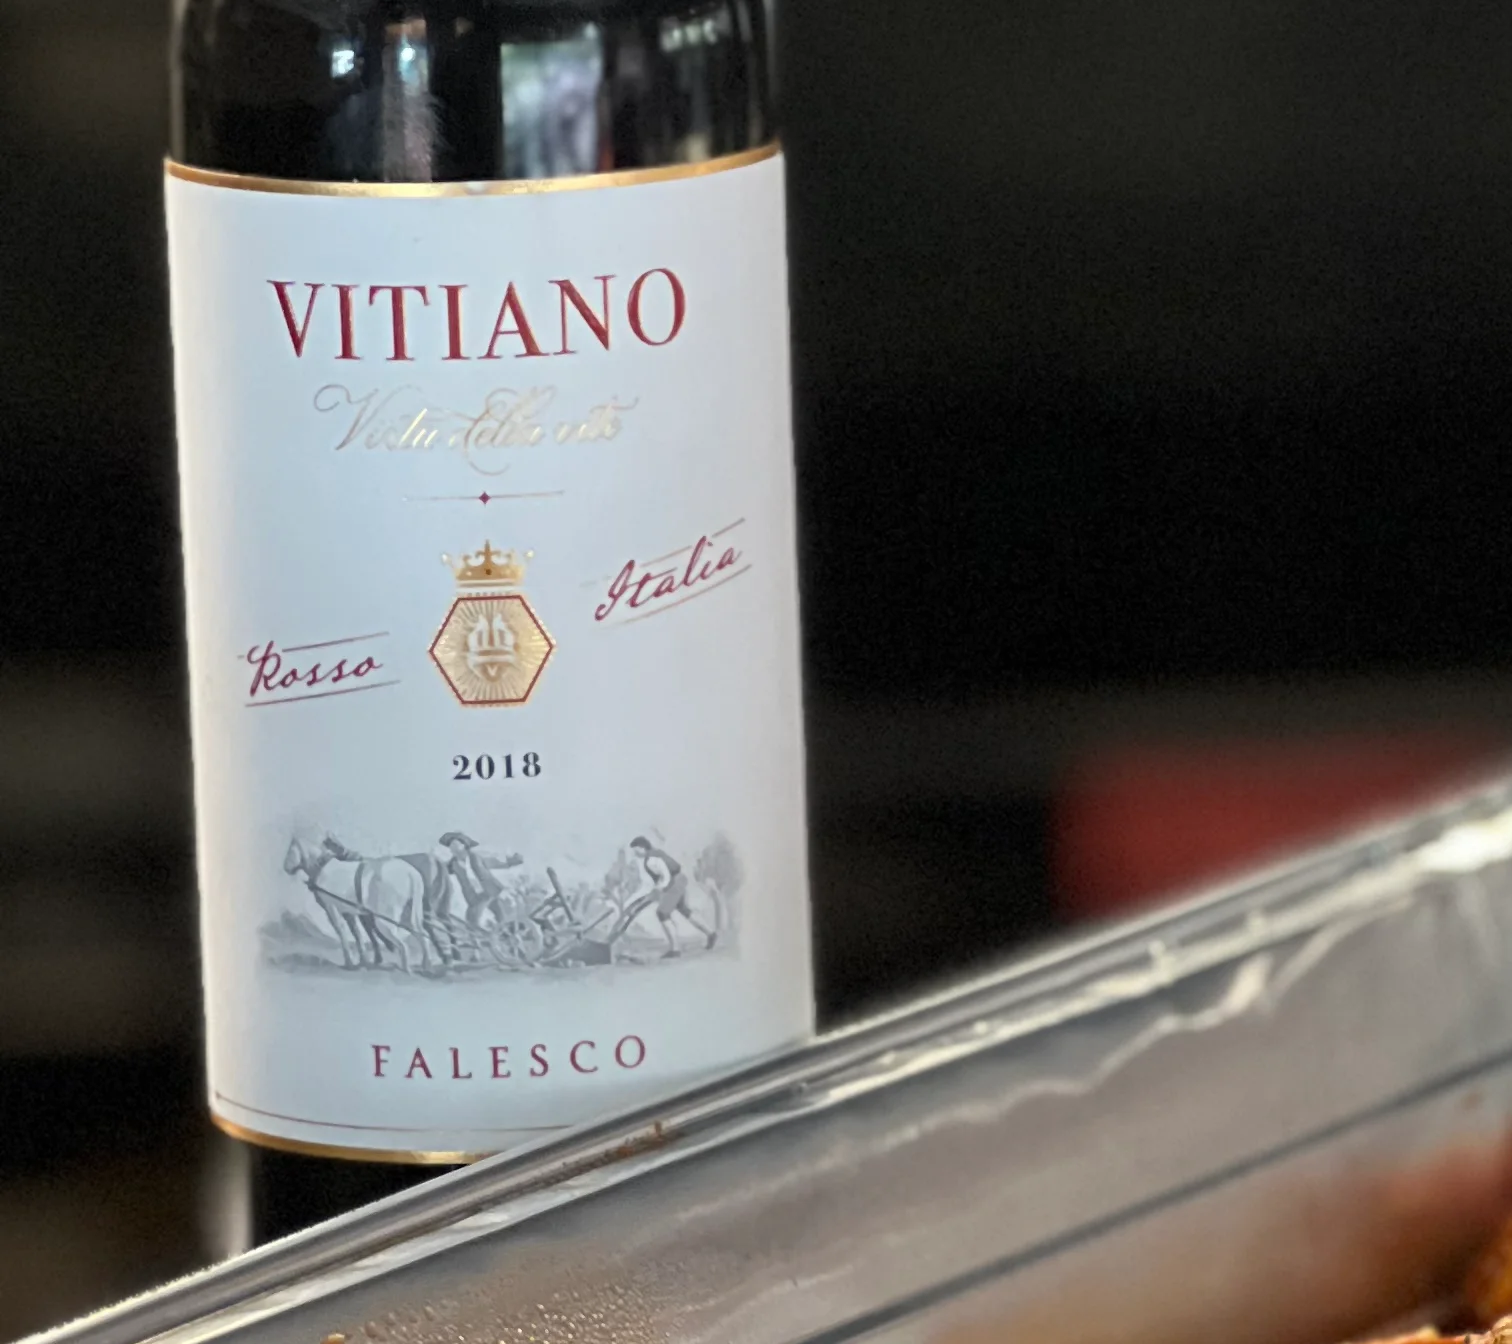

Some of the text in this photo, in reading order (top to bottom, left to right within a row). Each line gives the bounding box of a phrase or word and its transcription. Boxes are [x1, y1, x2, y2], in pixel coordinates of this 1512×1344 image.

[266, 267, 687, 362] VITIANO
[593, 534, 744, 622] Italia
[246, 639, 384, 698] Rosso
[452, 751, 542, 781] 2018
[370, 1034, 647, 1080] FALESCO
